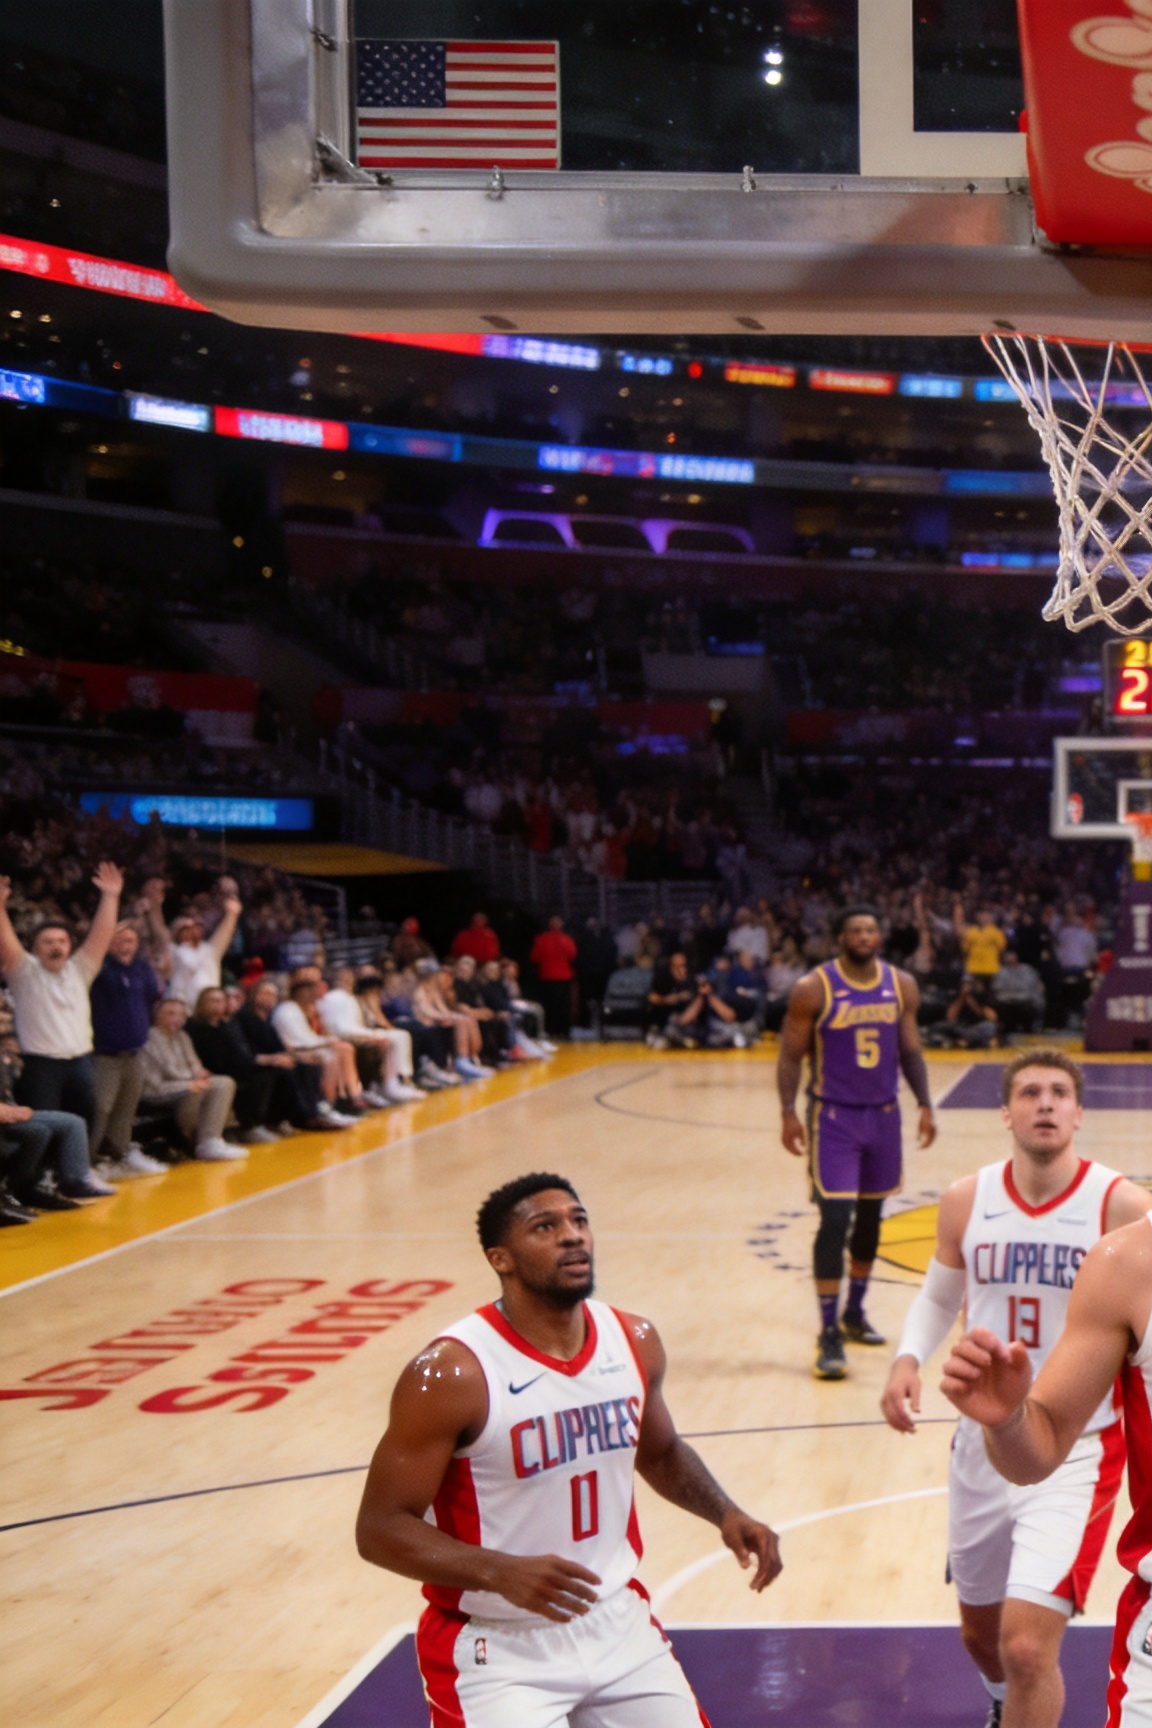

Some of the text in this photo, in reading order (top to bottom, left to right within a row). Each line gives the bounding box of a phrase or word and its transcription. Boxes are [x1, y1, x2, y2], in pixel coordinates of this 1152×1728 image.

[855, 1028, 880, 1069] 5
[1008, 1296, 1041, 1348] 13
[570, 1470, 599, 1542] 0
